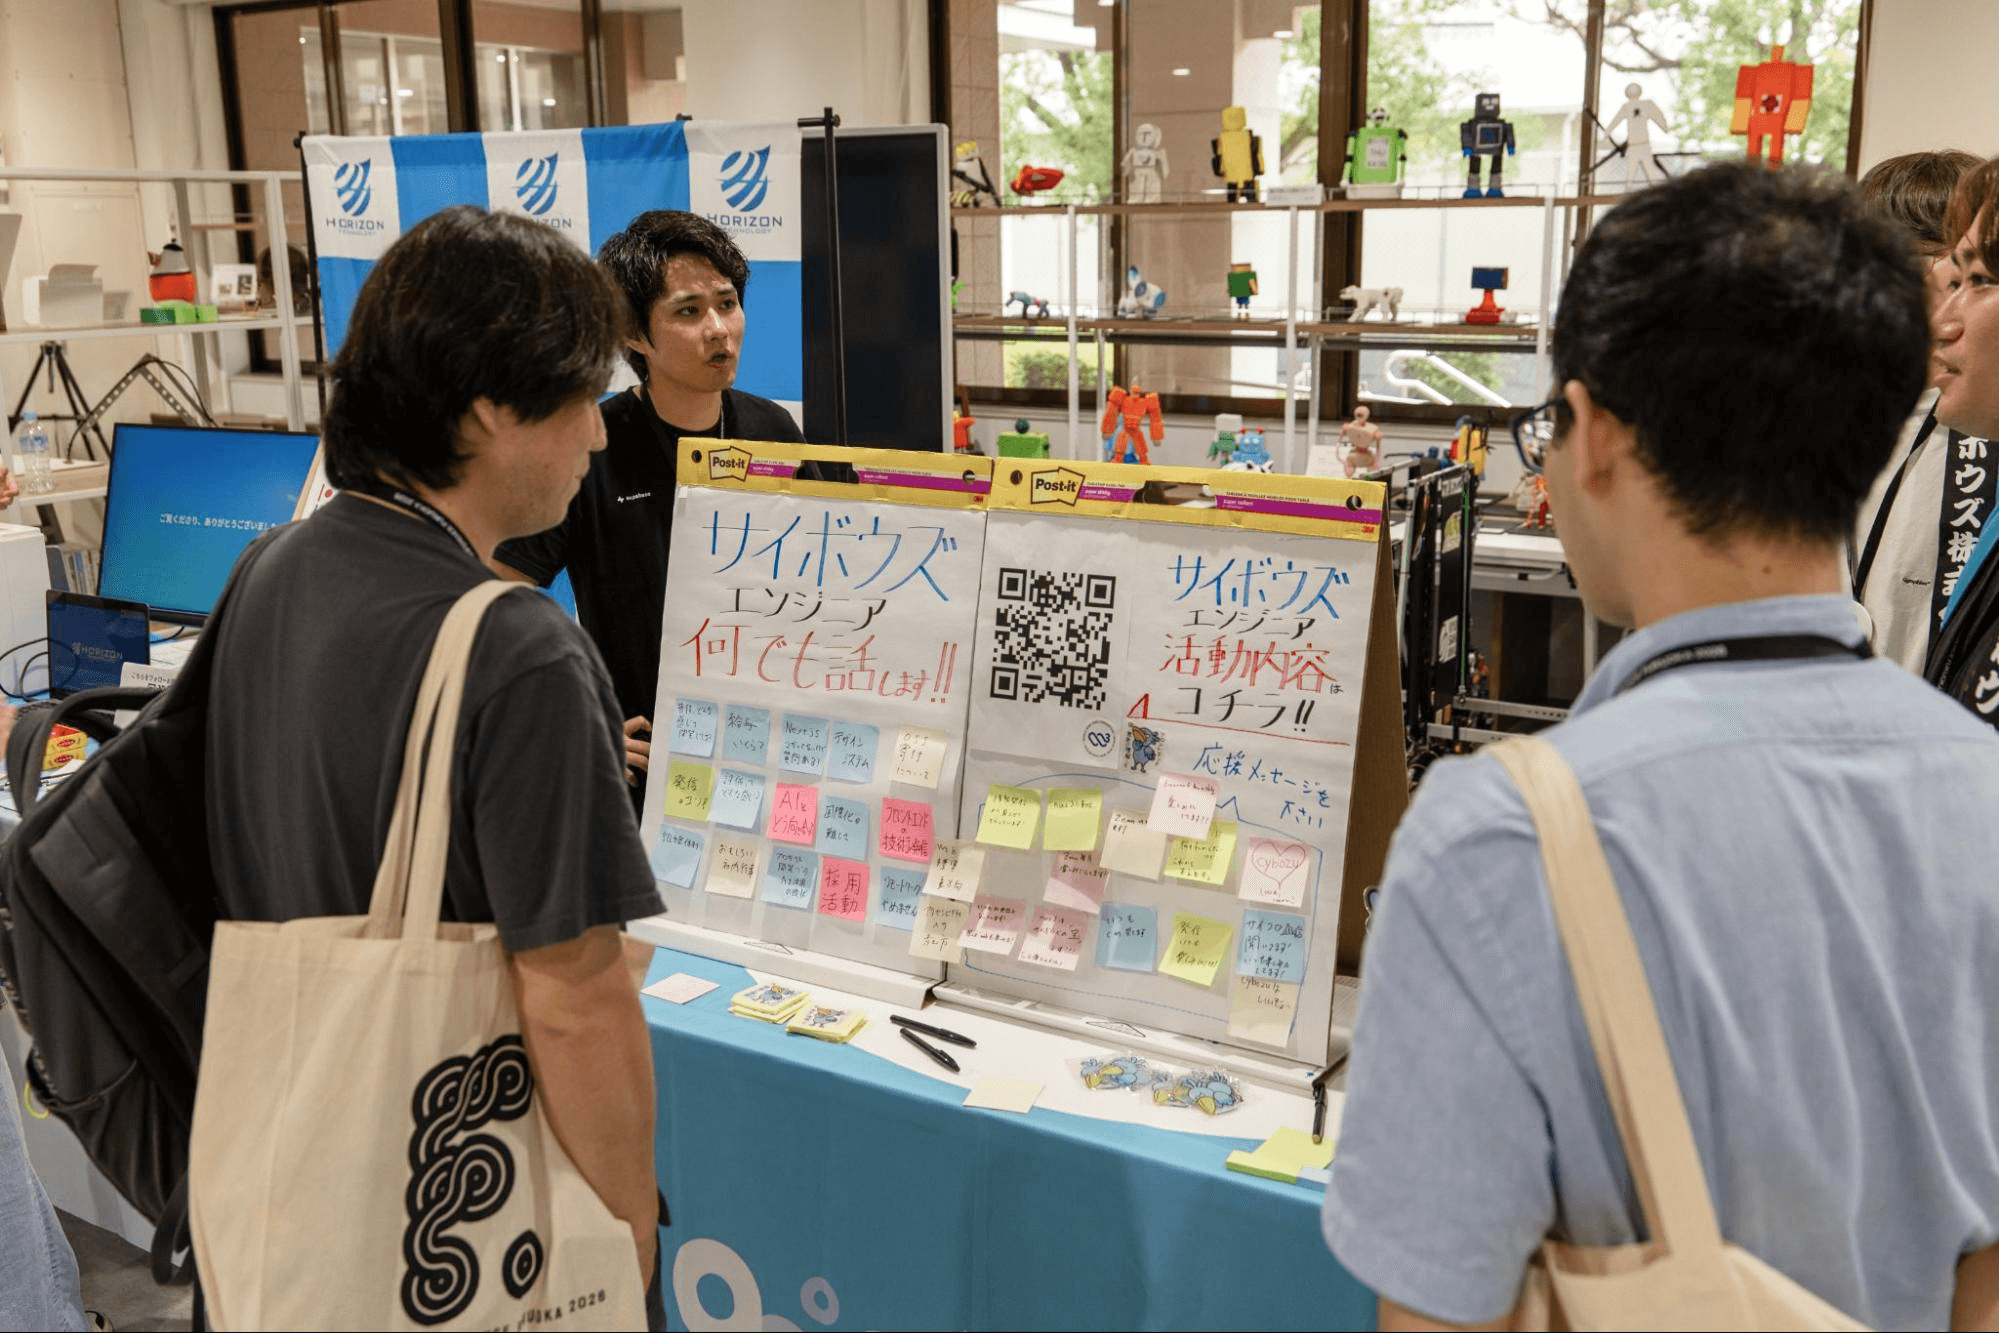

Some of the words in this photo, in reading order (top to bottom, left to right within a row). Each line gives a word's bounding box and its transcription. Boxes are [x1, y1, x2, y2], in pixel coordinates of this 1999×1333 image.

[712, 456, 745, 469] Post-it
[1035, 478, 1077, 493] Post-it
[701, 510, 958, 602] サイボウズ
[1166, 553, 1350, 620] サイボウズ
[719, 587, 887, 632] エンジニア
[1182, 608, 1316, 641] エンジニア
[825, 868, 861, 896] 採用
[820, 893, 859, 915] 活動
